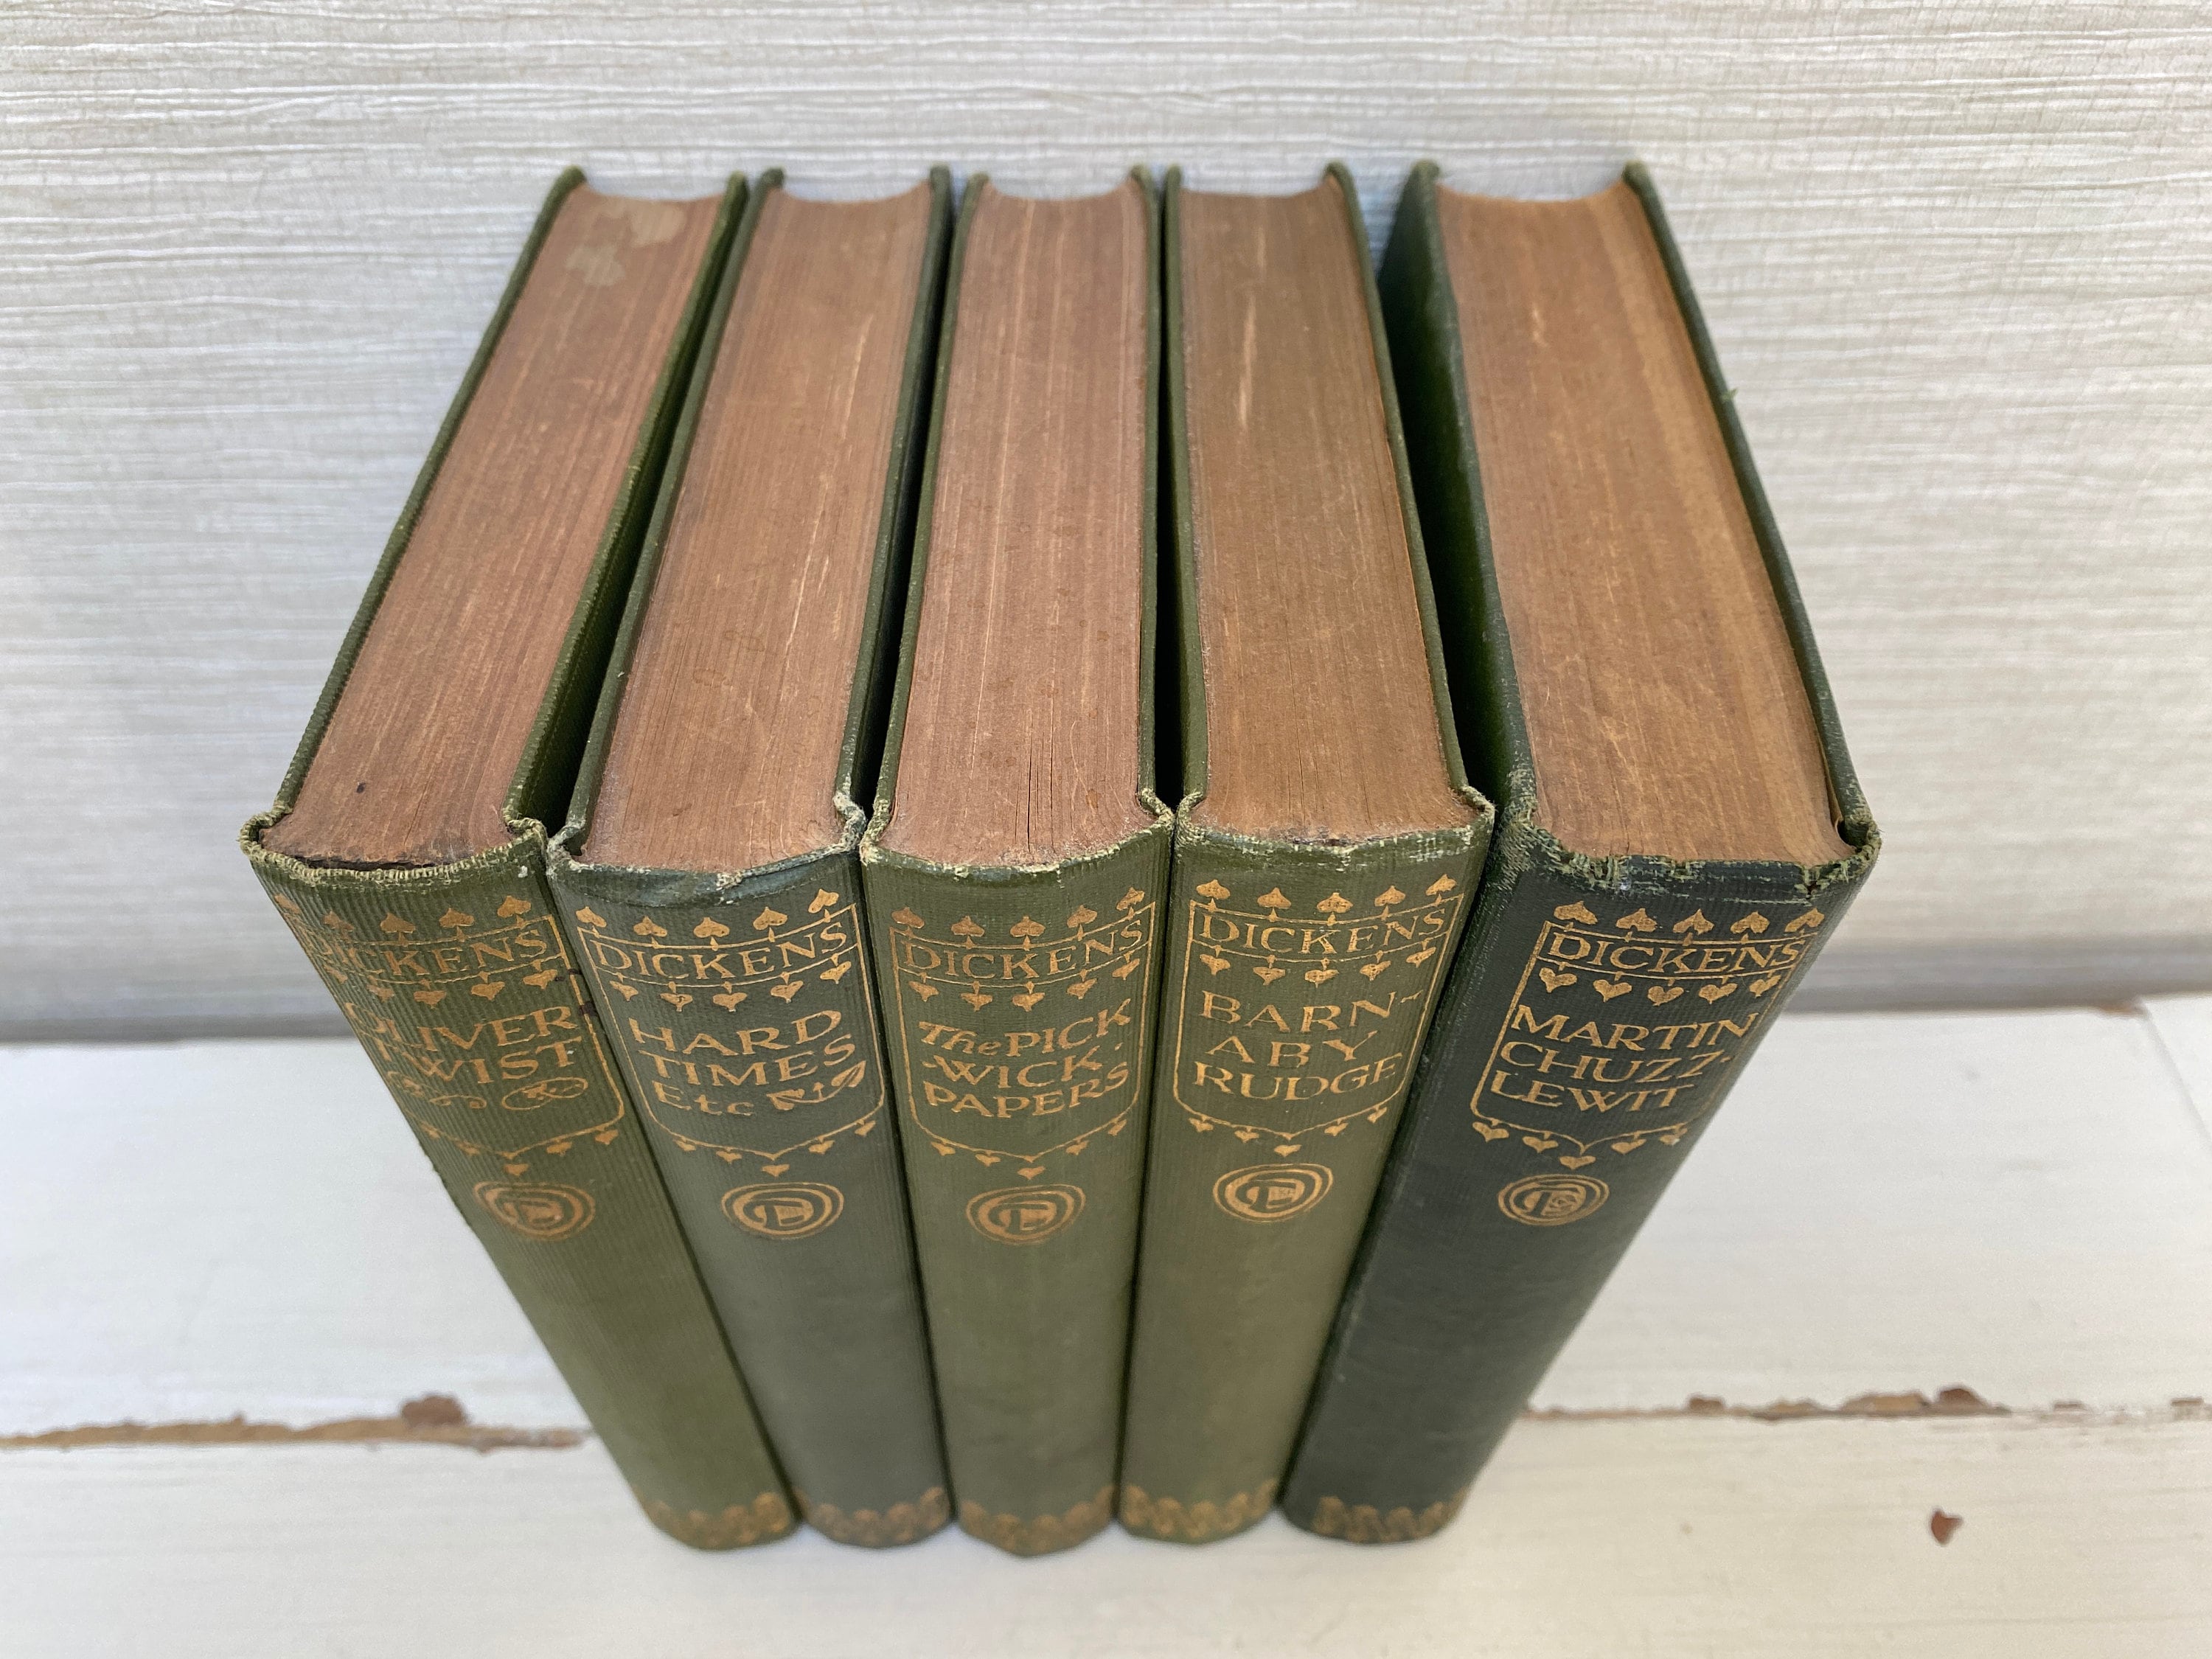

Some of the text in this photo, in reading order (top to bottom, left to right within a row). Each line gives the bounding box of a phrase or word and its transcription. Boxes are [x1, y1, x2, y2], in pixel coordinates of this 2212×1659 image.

[591, 922, 848, 979] DICKENS
[903, 919, 1143, 979] DICKENS
[1200, 909, 1447, 955] DICKENS
[1548, 932, 1807, 974] DICKENS
[629, 1010, 841, 1056] HARD
[919, 998, 1131, 1057] The PICK
[1205, 1030, 1377, 1067] ABY
[1511, 1005, 1759, 1051] MARTIN
[638, 1034, 855, 1086] TIMES
[1193, 1052, 1402, 1100] RUDGE
[923, 1062, 1129, 1118] PAPERS
[1491, 1070, 1694, 1112] LEWIT
